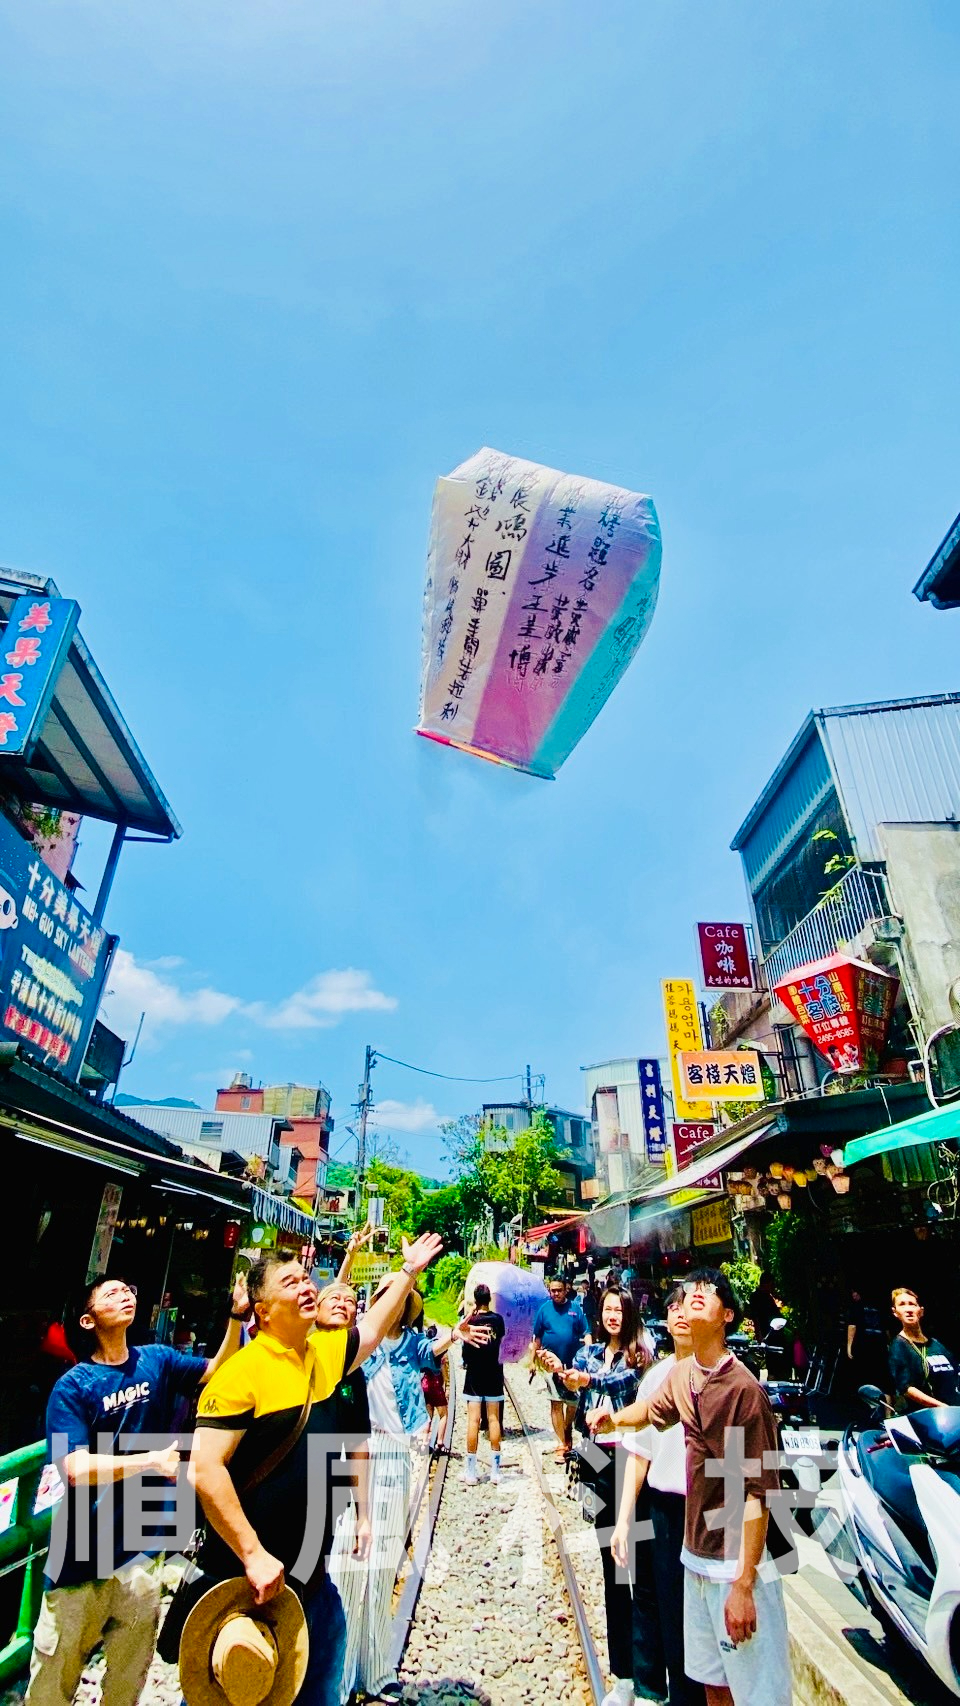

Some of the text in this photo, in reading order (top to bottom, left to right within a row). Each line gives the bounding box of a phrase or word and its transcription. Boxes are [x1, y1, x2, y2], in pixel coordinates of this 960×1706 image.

[704, 926, 739, 938] Cafe
[714, 939, 737, 974] 咖啡
[797, 975, 832, 1004] 十分
[804, 993, 844, 1022] 客棧
[687, 1063, 757, 1084] 客棧天燈
[678, 1126, 710, 1139] Cafe
[103, 1381, 151, 1412] MAGIC
